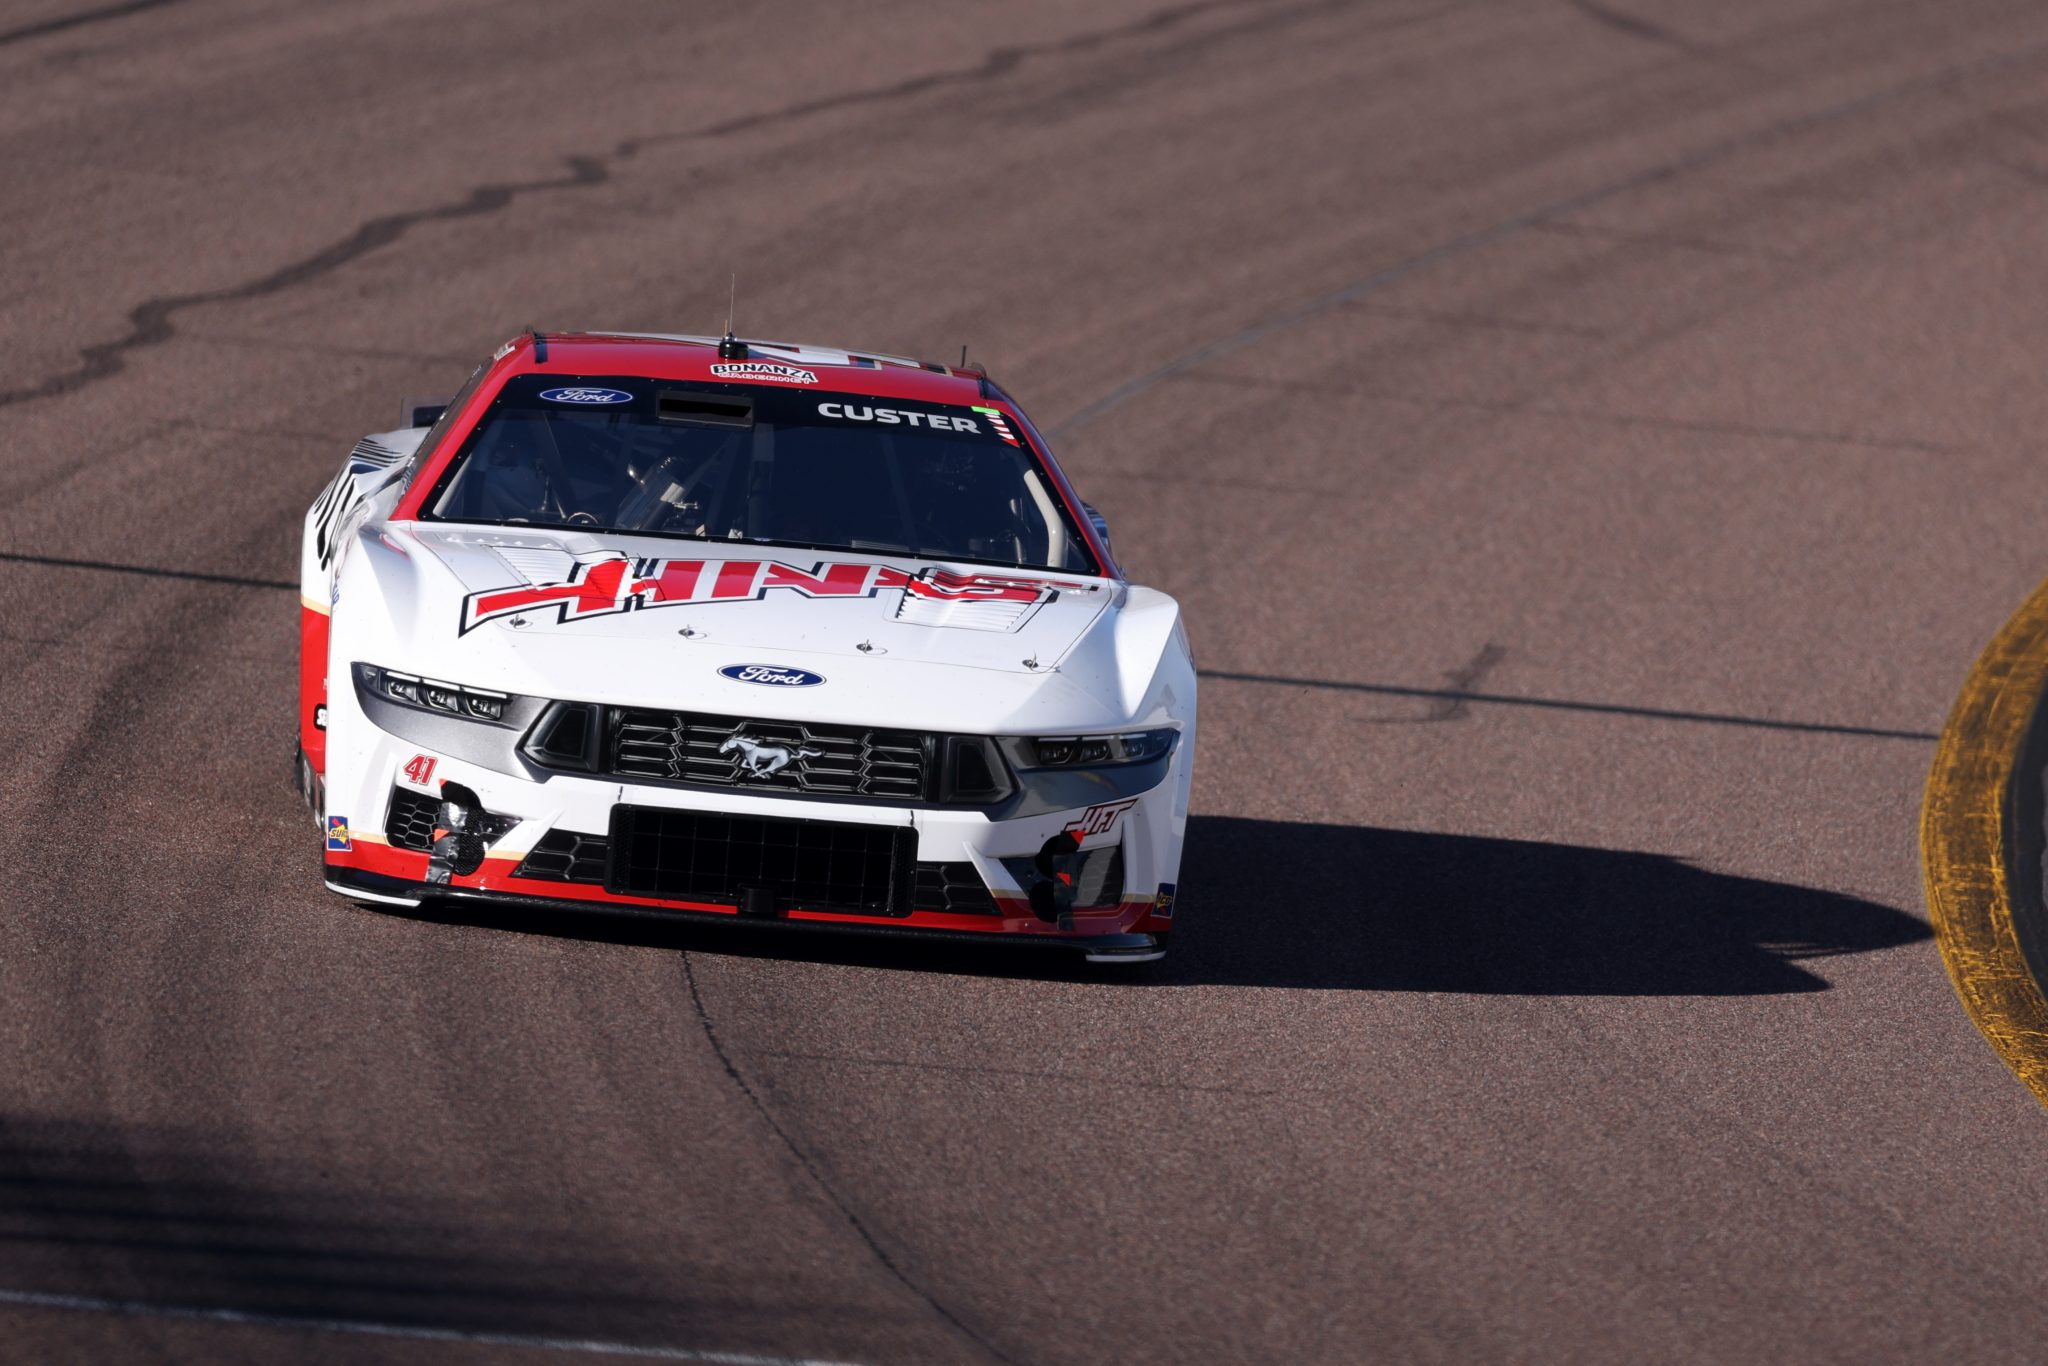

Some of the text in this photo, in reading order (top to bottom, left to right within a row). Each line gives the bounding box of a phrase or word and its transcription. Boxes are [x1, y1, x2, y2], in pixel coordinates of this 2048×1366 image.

[711, 363, 818, 382] BONANZA
[556, 389, 616, 402] Ford
[818, 403, 981, 434] CUSTER
[738, 665, 805, 685] Ford
[403, 754, 437, 786] 41
